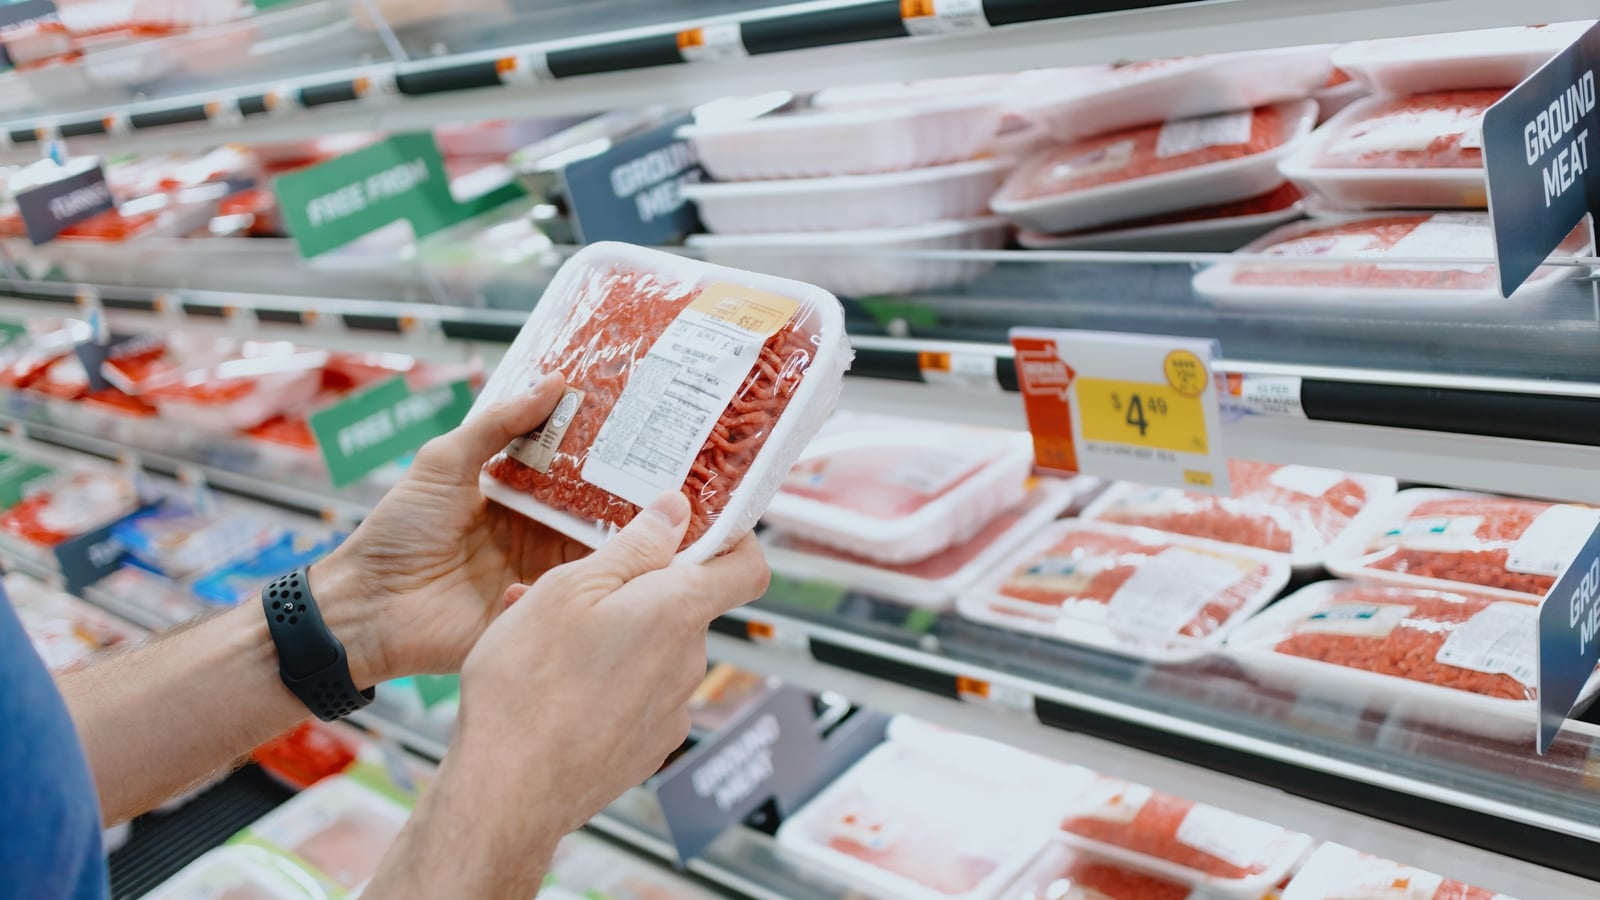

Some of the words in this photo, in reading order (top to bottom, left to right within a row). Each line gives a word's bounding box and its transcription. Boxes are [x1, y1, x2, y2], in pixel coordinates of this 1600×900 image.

[1524, 69, 1596, 166] GROUND
[306, 181, 366, 228] FREE
[366, 157, 429, 204] FROM
[1542, 128, 1589, 208] MEAT
[338, 408, 394, 458] FREE
[1570, 556, 1600, 630] GRO
[691, 713, 780, 798] GROUND
[715, 745, 774, 812] MEAT
